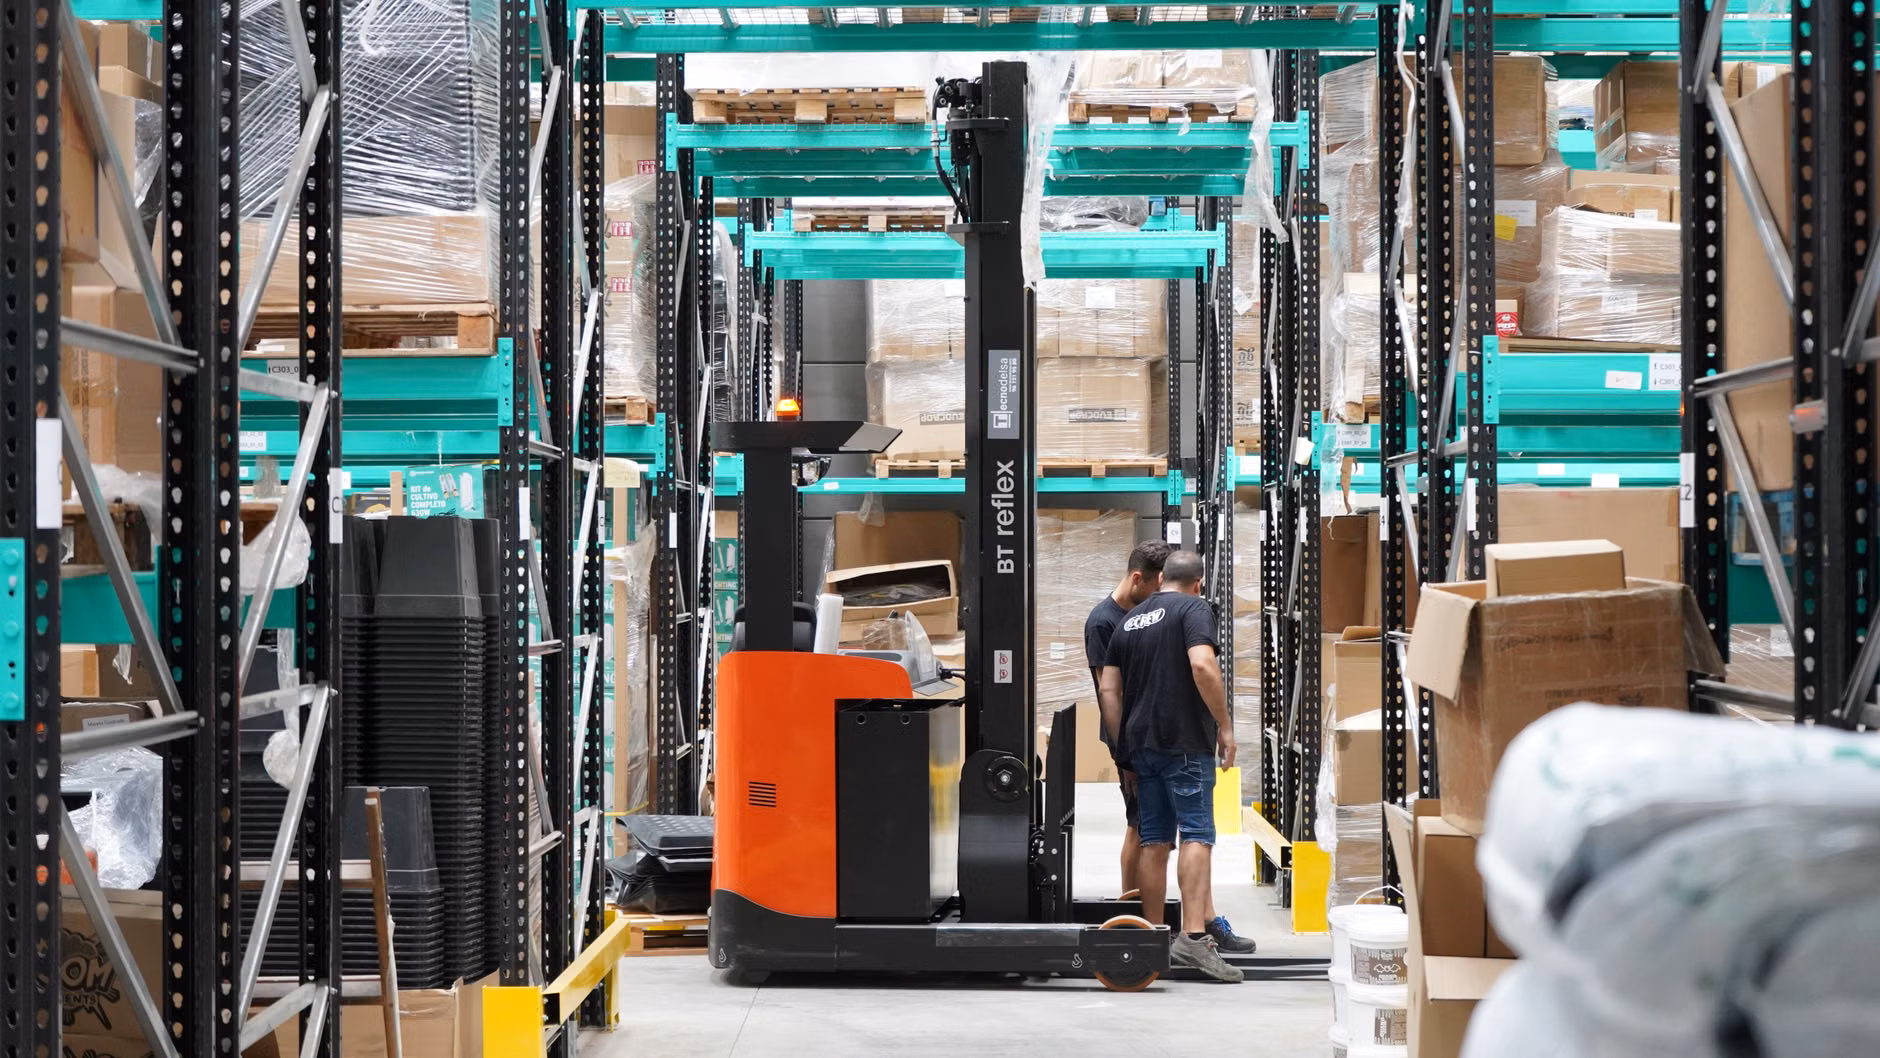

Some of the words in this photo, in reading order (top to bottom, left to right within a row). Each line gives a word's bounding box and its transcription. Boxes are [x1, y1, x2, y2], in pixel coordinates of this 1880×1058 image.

[411, 485, 420, 493] KIT
[422, 485, 431, 493] de
[411, 493, 438, 501] CULTIVO
[991, 459, 1014, 536] reflex
[411, 500, 446, 509] COMPLETO
[997, 544, 1014, 574] BT
